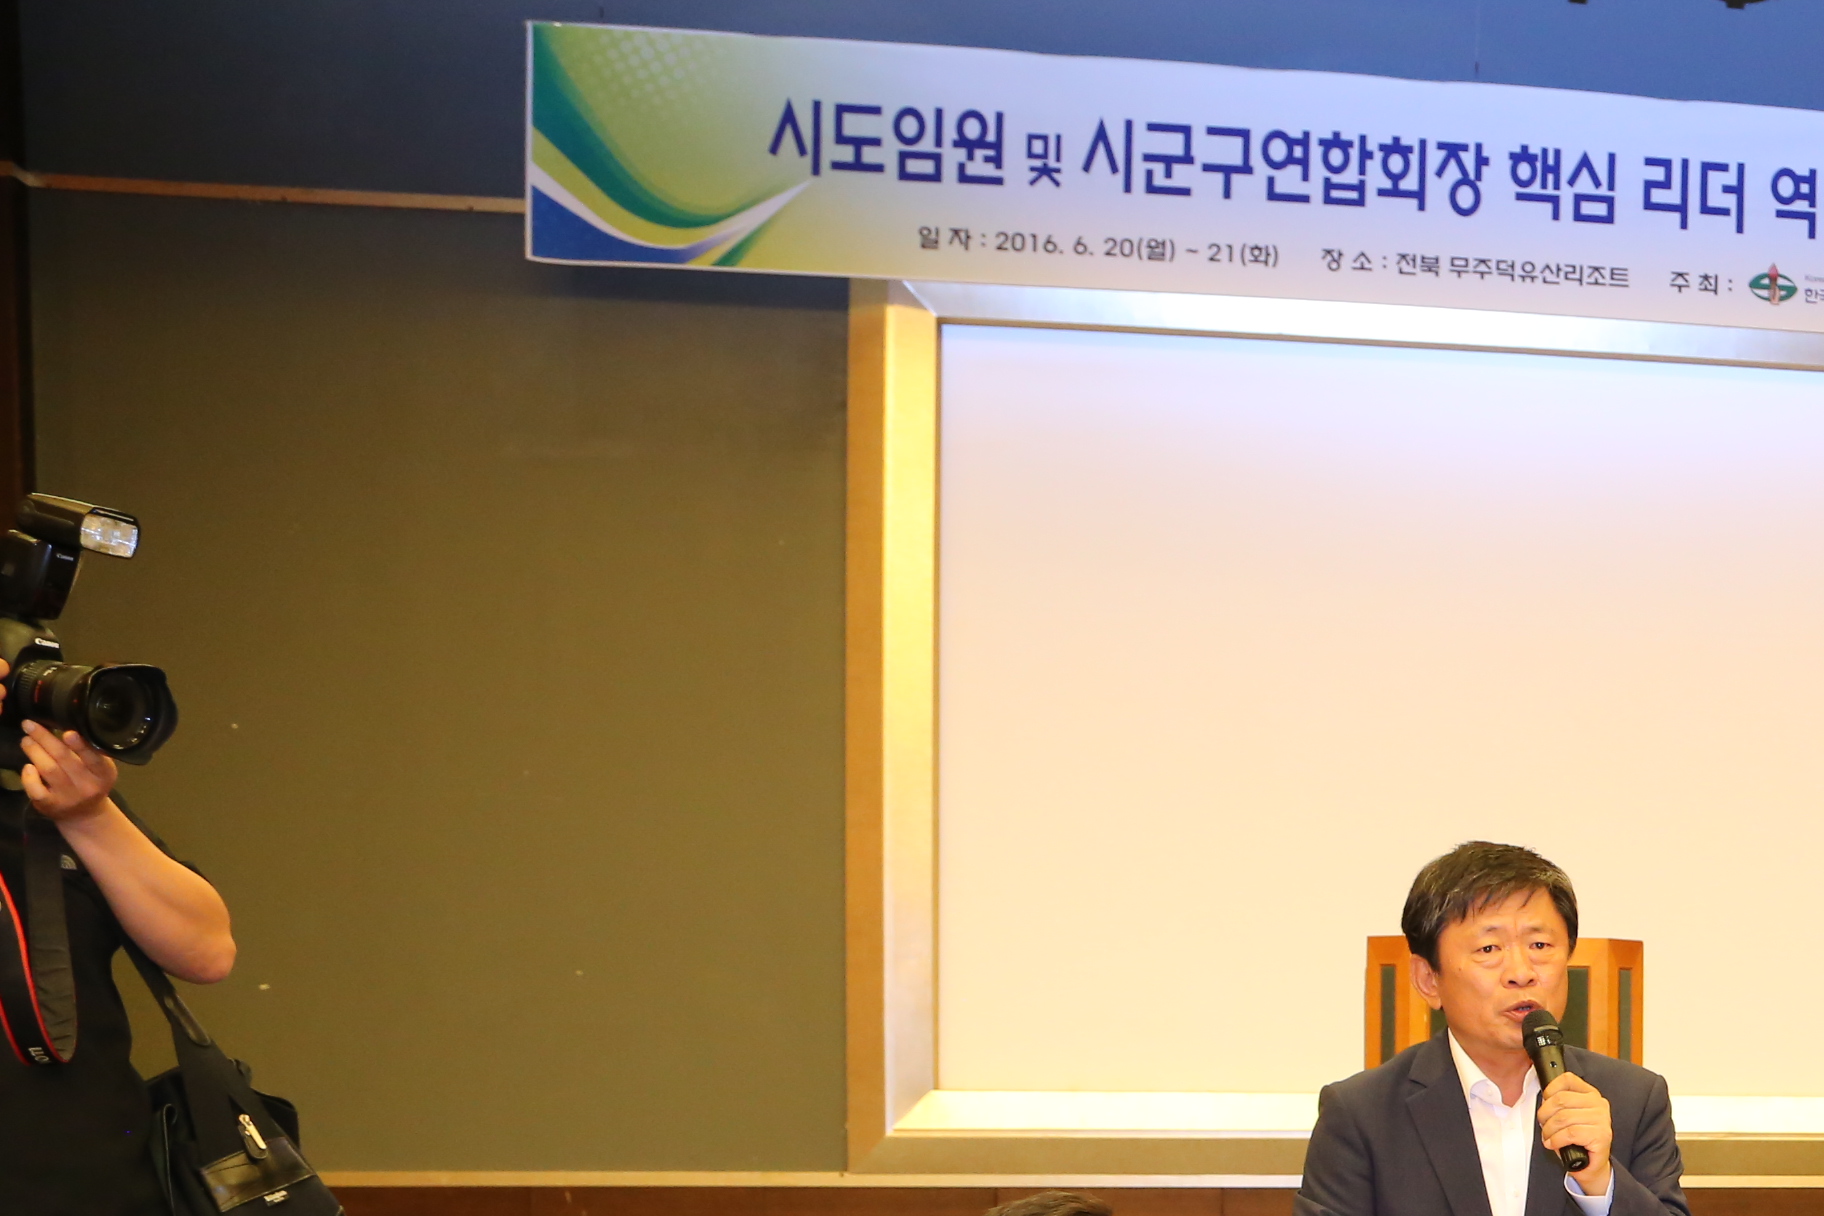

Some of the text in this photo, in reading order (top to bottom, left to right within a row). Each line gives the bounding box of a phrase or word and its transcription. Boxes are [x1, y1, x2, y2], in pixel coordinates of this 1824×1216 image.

[768, 97, 1004, 185] 시도임원
[1027, 133, 1061, 187] 및
[1082, 117, 1489, 217] 시군구연합회장
[1508, 144, 1616, 224] 핵심
[1643, 156, 1745, 234] 리더
[995, 232, 1063, 255] 2016.
[1073, 236, 1093, 256] 6.
[1104, 237, 1175, 263] 20(월)
[1207, 243, 1278, 268] 21(화)
[1396, 252, 1440, 277] 전북
[1449, 256, 1629, 288] 무주덕유산리조트
